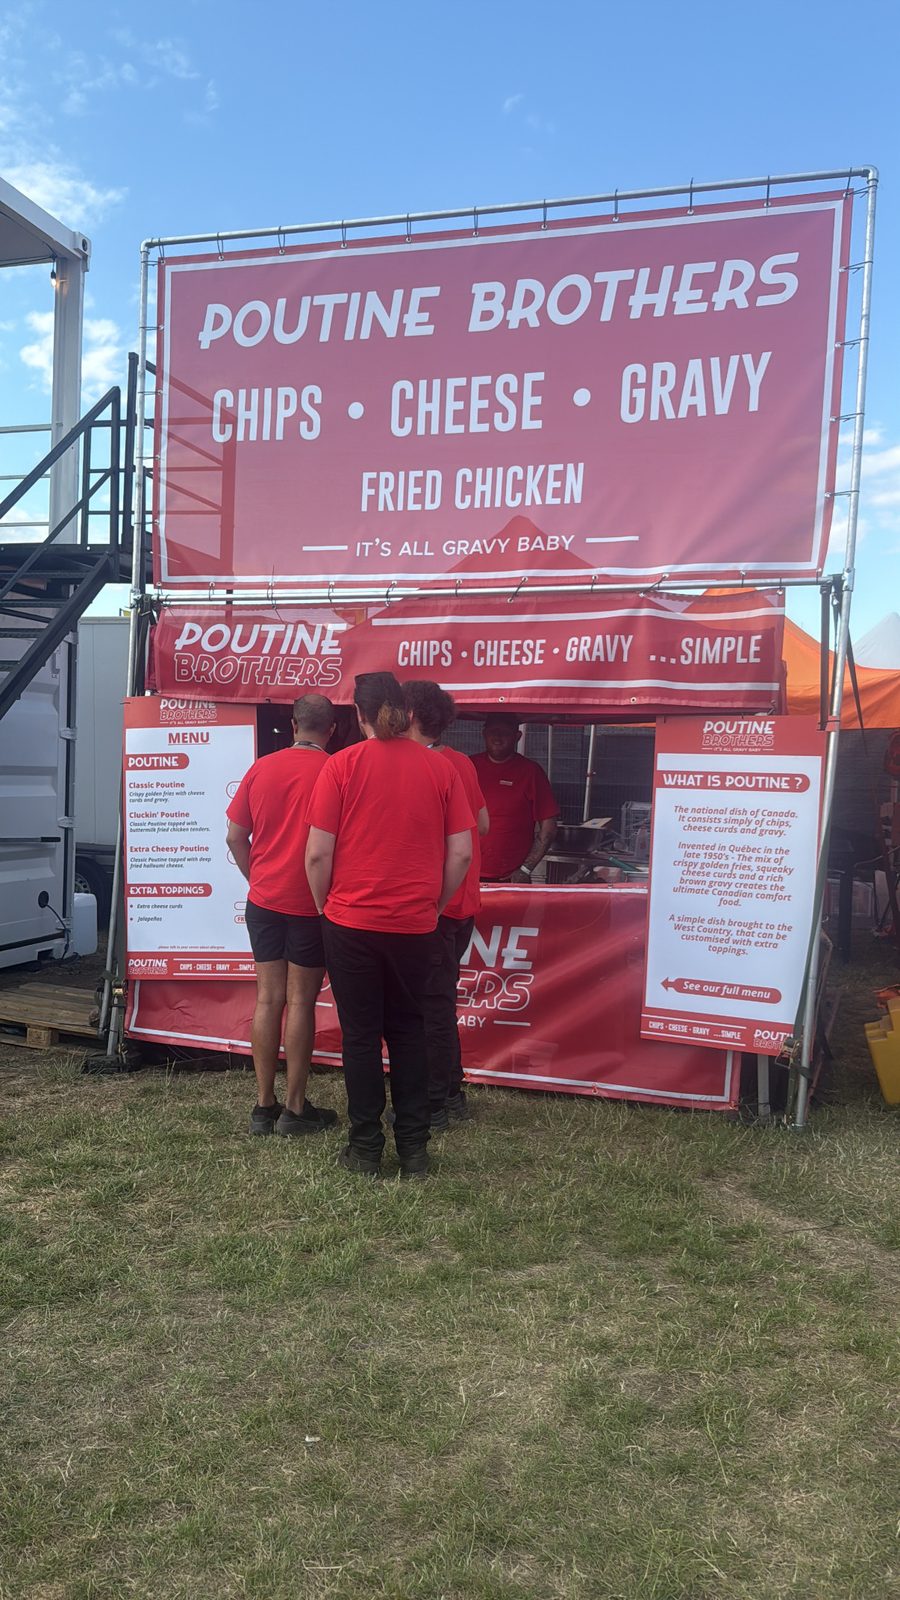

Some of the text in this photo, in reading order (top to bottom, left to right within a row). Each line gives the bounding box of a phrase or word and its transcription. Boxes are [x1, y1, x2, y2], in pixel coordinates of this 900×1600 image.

[199, 252, 800, 350] POUTINE BROTHERS
[211, 351, 772, 444] CHIPS CHEESE GRAVY
[361, 462, 584, 512] FRIED CHICKEN
[398, 540, 434, 556] ALL
[442, 538, 510, 556] GRAVY
[517, 535, 575, 552] BABY
[174, 622, 348, 655] POUTINE
[398, 640, 452, 667] CHIPS
[473, 639, 546, 667] CHEESE
[566, 634, 634, 662] GRAVY
[174, 653, 342, 686] BROTHERS
[160, 708, 218, 720] BROTHERS
[702, 721, 776, 734] POUTINE
[168, 732, 210, 744] MENU
[702, 734, 775, 746] BROTHERS
[128, 756, 179, 767] POUTINE
[663, 774, 703, 786] WHAT
[707, 775, 721, 787] IS
[725, 776, 790, 789] POUTINE
[674, 806, 798, 818] The national dish of Canada.
[689, 816, 722, 824] consists
[723, 816, 752, 827] simply
[754, 818, 765, 828] of
[766, 818, 792, 828] chips,
[683, 824, 787, 838] cheese curds and gravy.
[678, 842, 716, 851] Invented
[728, 844, 762, 854] Québec
[763, 846, 772, 854] in
[774, 847, 790, 855] the
[684, 851, 700, 859] late
[737, 854, 753, 862] The
[755, 854, 771, 863] mix
[773, 855, 784, 866] of
[673, 859, 794, 875] crispy golden fries, squeaky
[682, 868, 711, 877] cheese
[713, 870, 737, 879] curds
[739, 871, 756, 880] and
[766, 873, 783, 882] rich
[160, 886, 205, 894] TOPPINGS
[680, 877, 785, 891] brown gravy creates the
[673, 886, 792, 903] ultimate Canadian comfort
[718, 897, 742, 907] food.
[677, 915, 705, 925] simple
[707, 917, 726, 925] dish
[727, 918, 763, 929] brought
[777, 923, 793, 932] the
[674, 923, 696, 932] West
[697, 925, 733, 937] Country,
[736, 929, 755, 937] that
[776, 932, 787, 940] be
[681, 934, 778, 949] customised with extra
[708, 945, 748, 956] toppings.
[128, 958, 168, 967] POUTINE
[683, 982, 700, 991] See
[720, 985, 739, 996] full
[741, 990, 771, 999] menu
[457, 1016, 486, 1028] ABY
[754, 1029, 793, 1041] POUT
